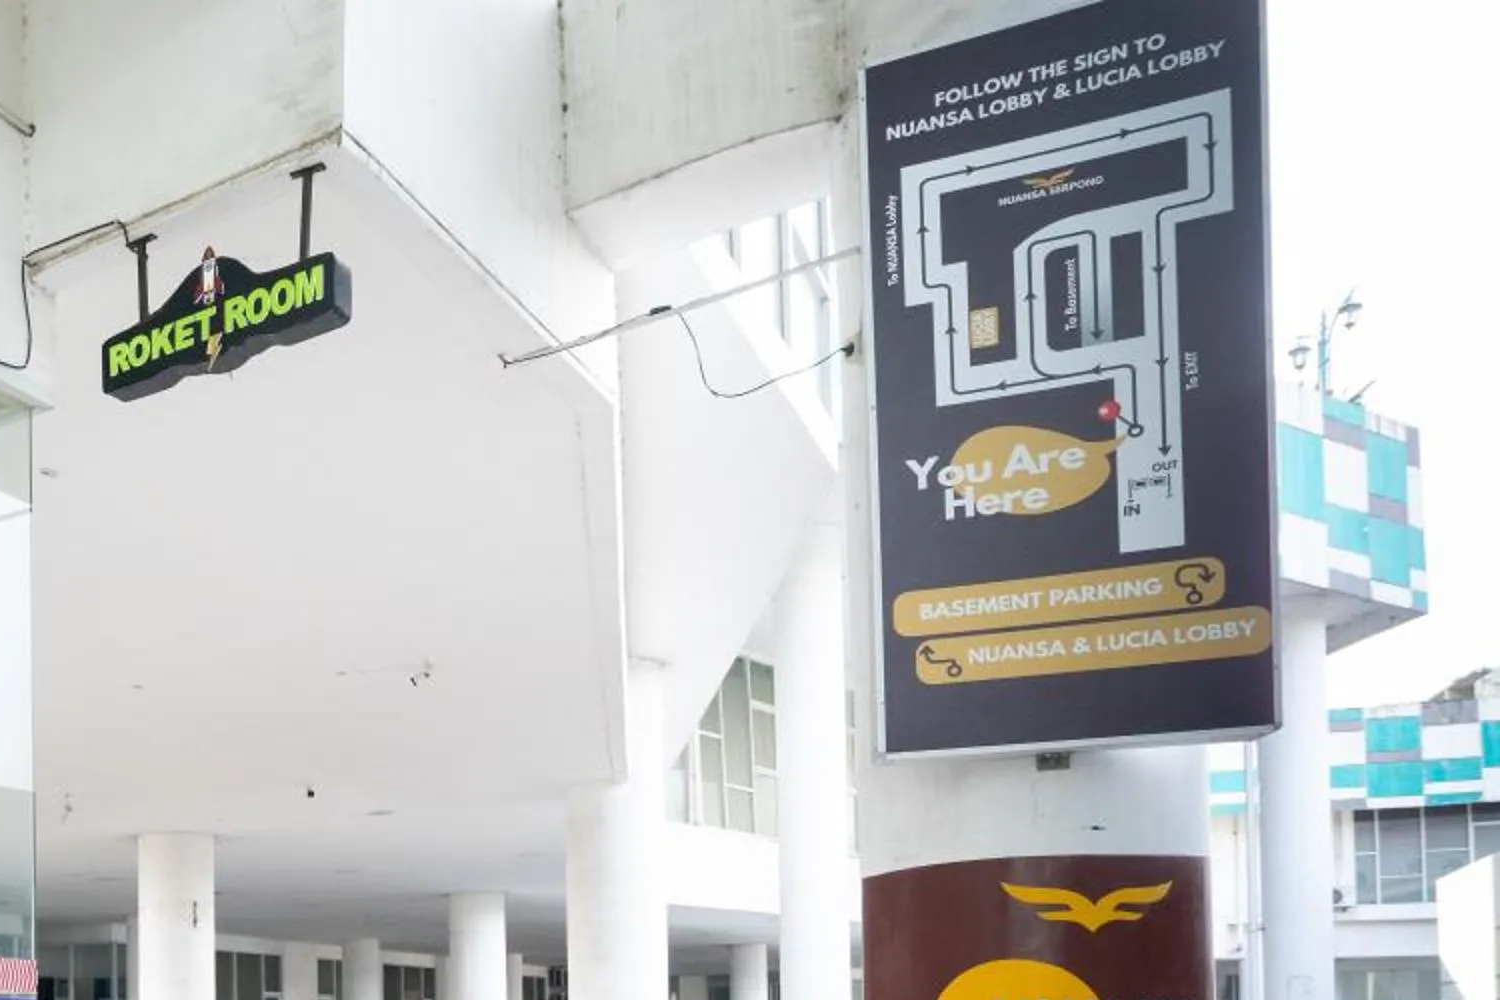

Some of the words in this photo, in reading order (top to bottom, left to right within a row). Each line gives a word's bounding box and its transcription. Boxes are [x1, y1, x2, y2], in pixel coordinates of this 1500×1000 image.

[885, 107, 975, 141] NUANSA
[977, 87, 1048, 119] LOBBY
[1052, 83, 1071, 100] &
[1075, 64, 1142, 94] LUCIA
[1147, 39, 1226, 76] LOBBY
[934, 71, 1024, 107] FOLLOW
[1028, 59, 1069, 83] THE
[1073, 43, 1128, 72] SIGN
[1133, 33, 1167, 55] TO
[884, 195, 898, 226] Lobby
[885, 227, 899, 273] NUANSA
[887, 273, 899, 287] To
[1064, 258, 1077, 315] Basement
[108, 305, 217, 377] ROKET
[222, 263, 325, 334] ROOM
[1064, 317, 1077, 332] To
[1185, 376, 1199, 391] To
[905, 455, 993, 491] You
[1001, 443, 1088, 478] Are
[1152, 459, 1178, 473] OUT
[944, 485, 1049, 520] Here
[1123, 503, 1141, 517] IN
[918, 591, 1044, 622] BASEMENT
[1048, 577, 1164, 608] PARKING
[967, 640, 1067, 665] NUANSA
[1072, 634, 1091, 653] &
[1097, 628, 1166, 652] LUCIA
[1173, 619, 1257, 646] LOBBY
